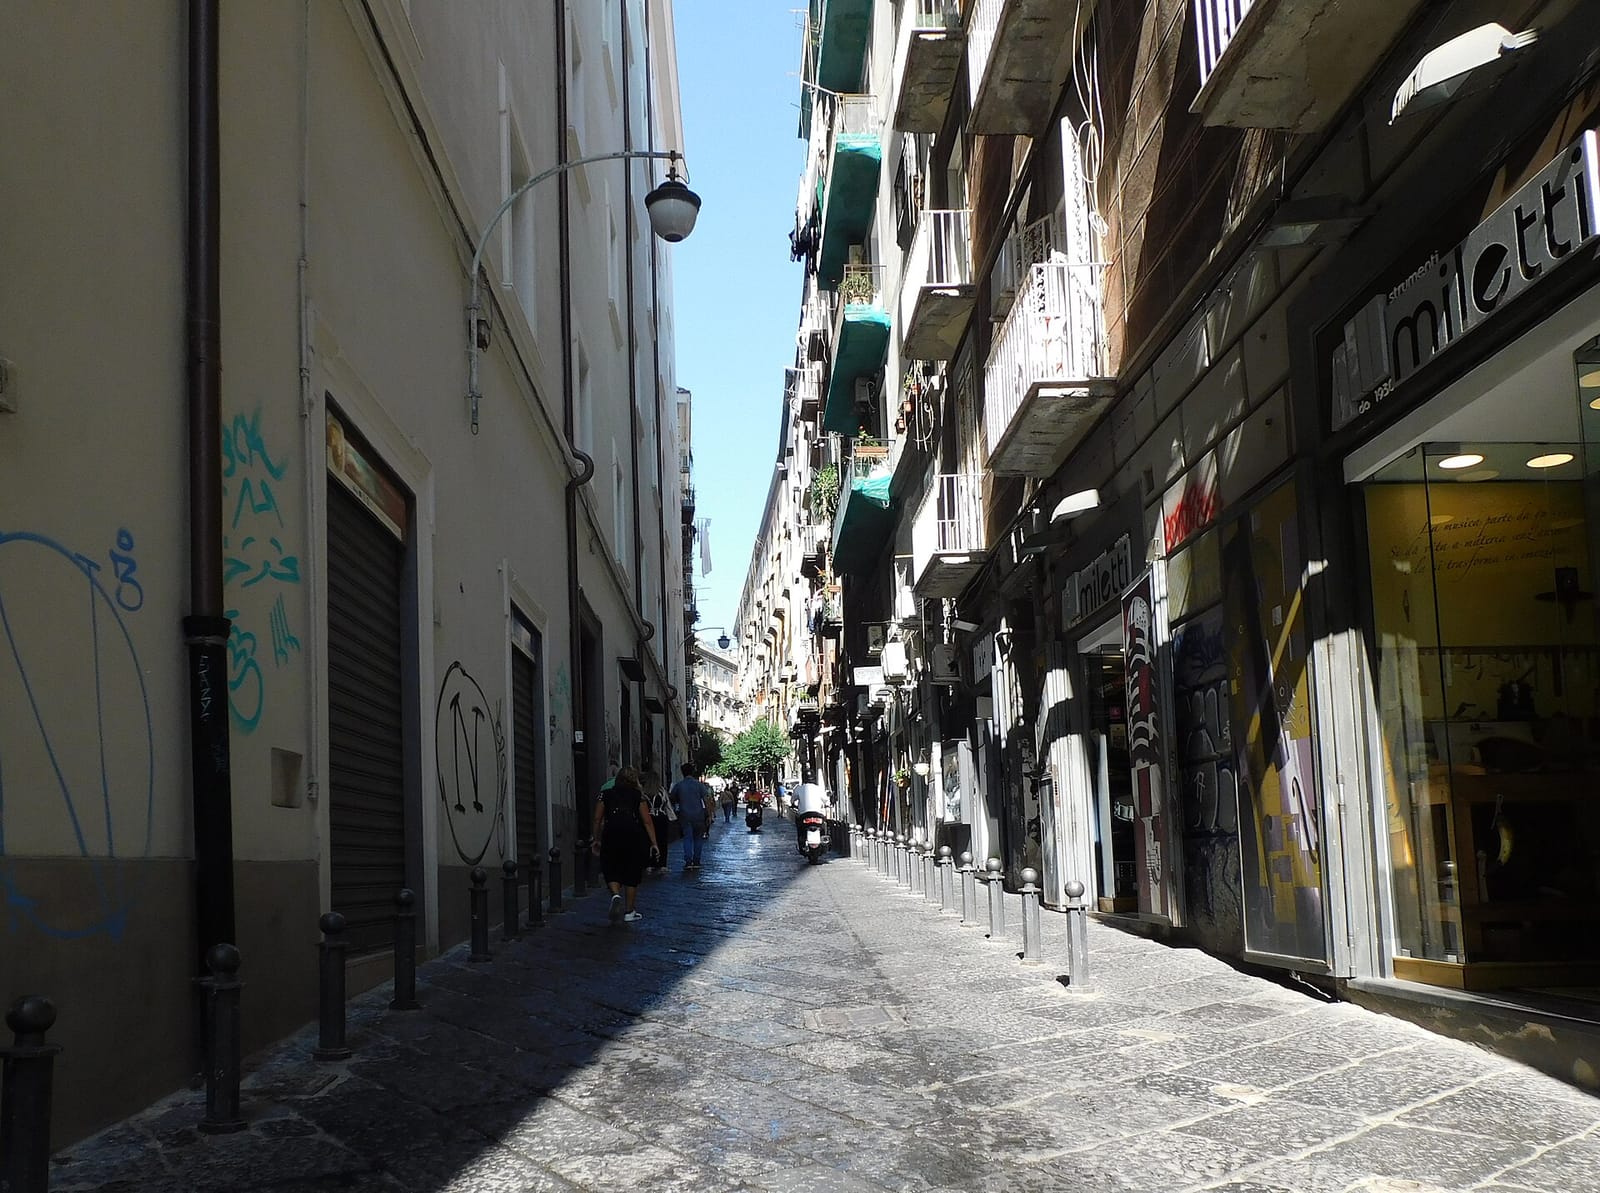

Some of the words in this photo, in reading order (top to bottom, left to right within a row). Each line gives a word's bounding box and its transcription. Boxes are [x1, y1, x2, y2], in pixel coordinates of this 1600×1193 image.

[1388, 249, 1440, 305] strumenti
[1392, 145, 1590, 381] miletti
[1358, 400, 1371, 414] da
[1443, 519, 1480, 531] musica
[1080, 542, 1130, 619] miletti
